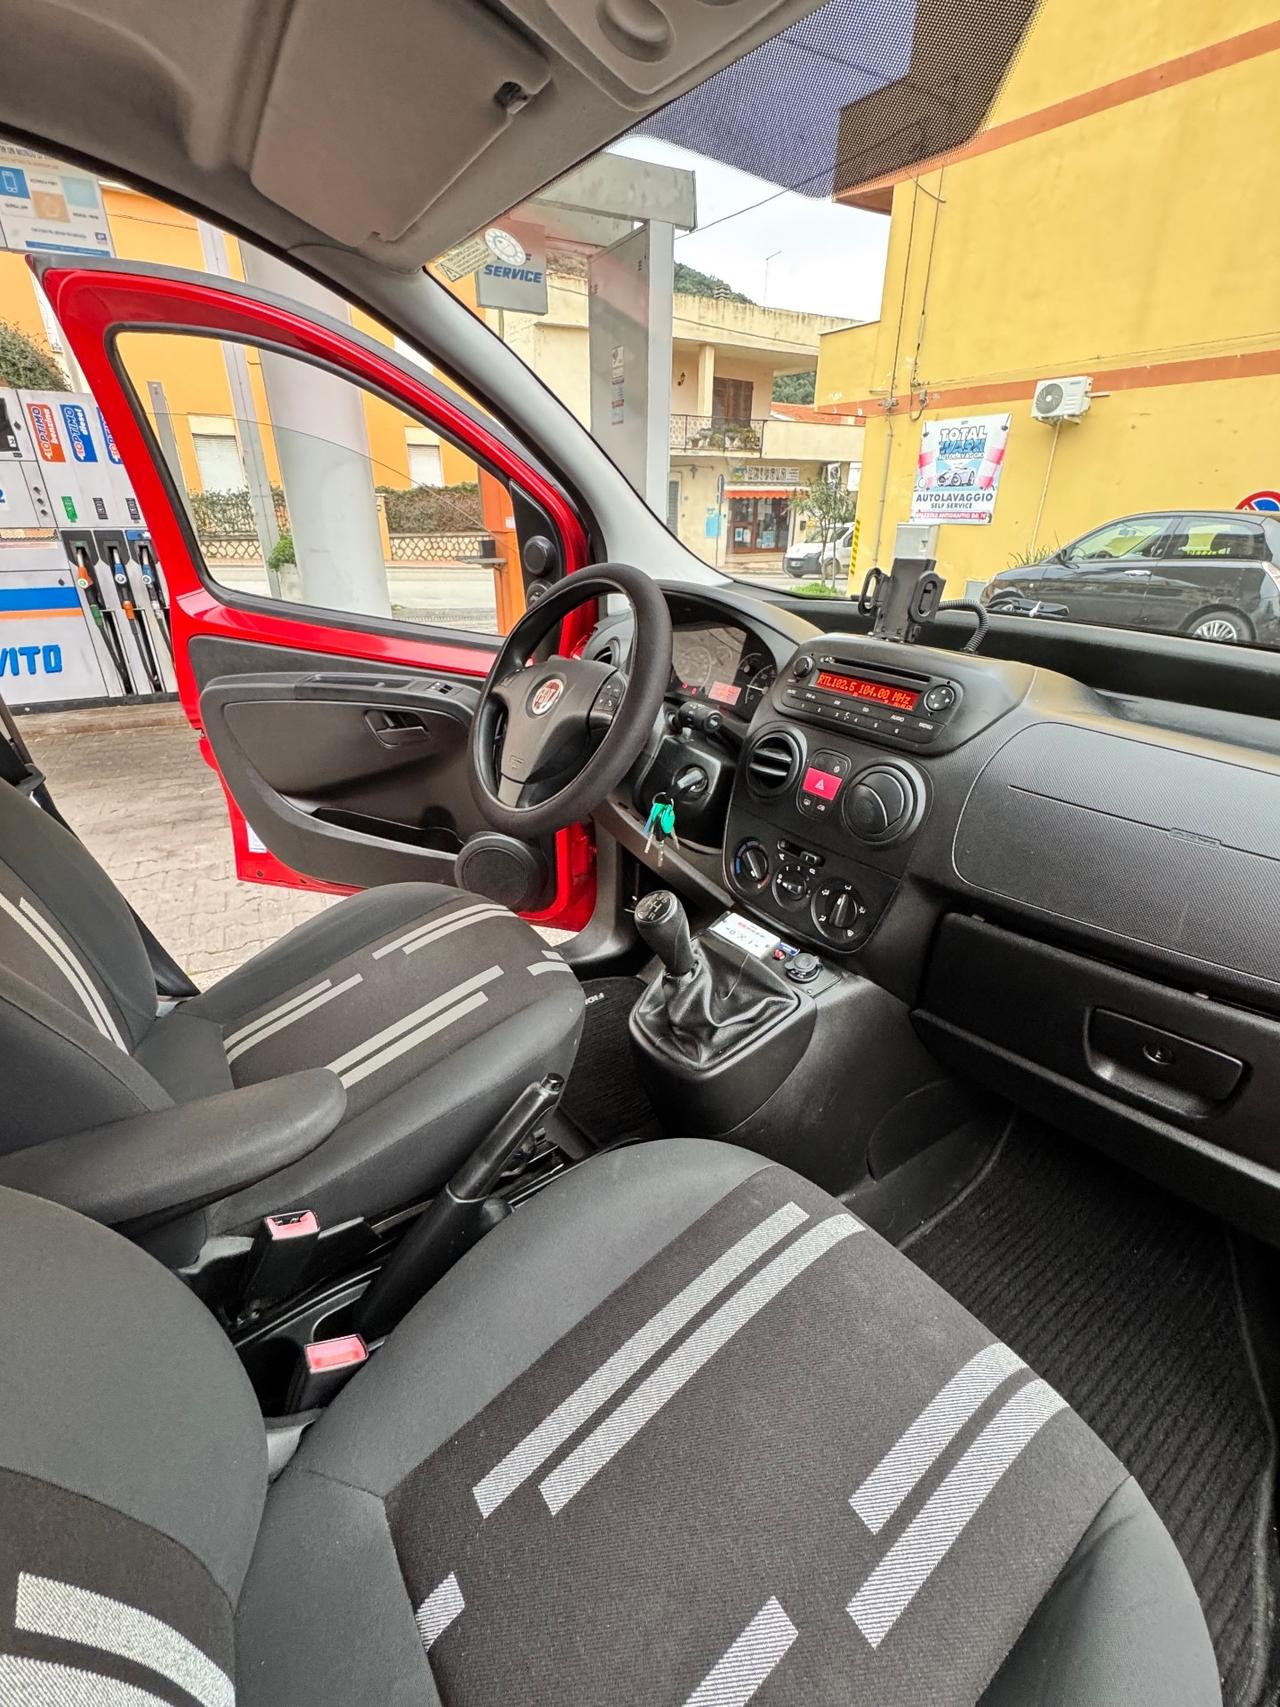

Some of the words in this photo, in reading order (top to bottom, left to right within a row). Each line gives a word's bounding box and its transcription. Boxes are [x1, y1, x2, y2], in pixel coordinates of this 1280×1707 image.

[484, 264, 543, 283] SERVICE
[940, 425, 988, 442] TOTAL
[916, 492, 993, 502] AUTOLAVAGGIO
[817, 673, 855, 691] RTL102.5
[858, 683, 890, 700] 104.00
[892, 691, 911, 704] MHz
